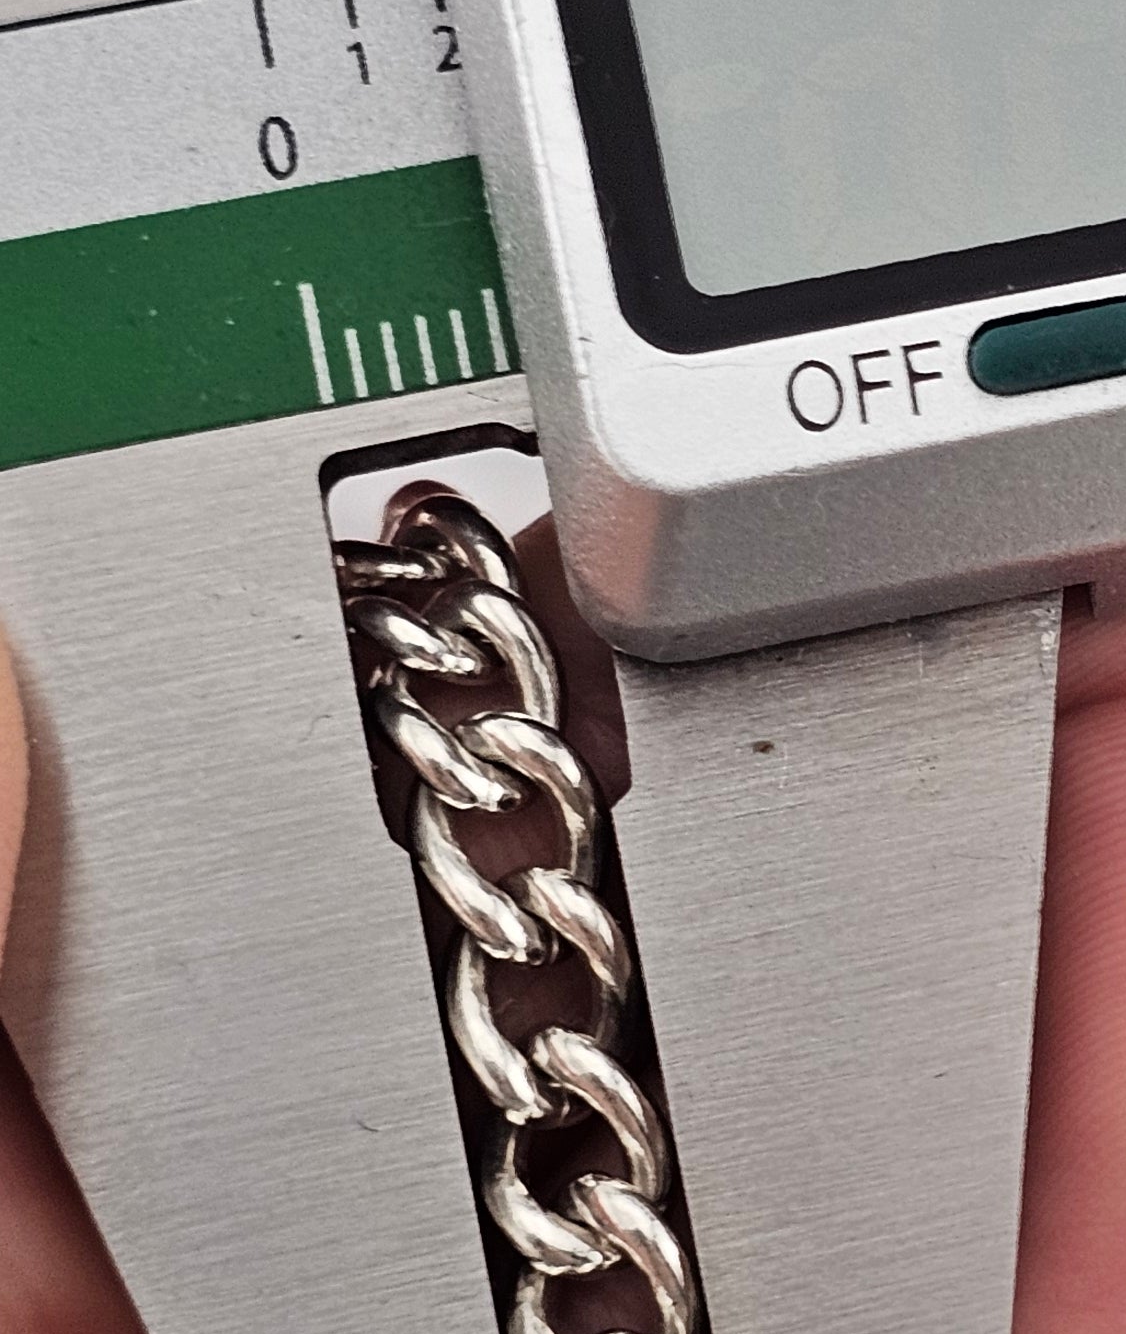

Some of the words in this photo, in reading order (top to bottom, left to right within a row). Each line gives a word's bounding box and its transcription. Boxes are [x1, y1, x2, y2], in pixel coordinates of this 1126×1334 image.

[346, 41, 370, 85] 1
[432, 25, 462, 72] 2
[258, 116, 298, 180] 0
[786, 338, 943, 432] OFF
